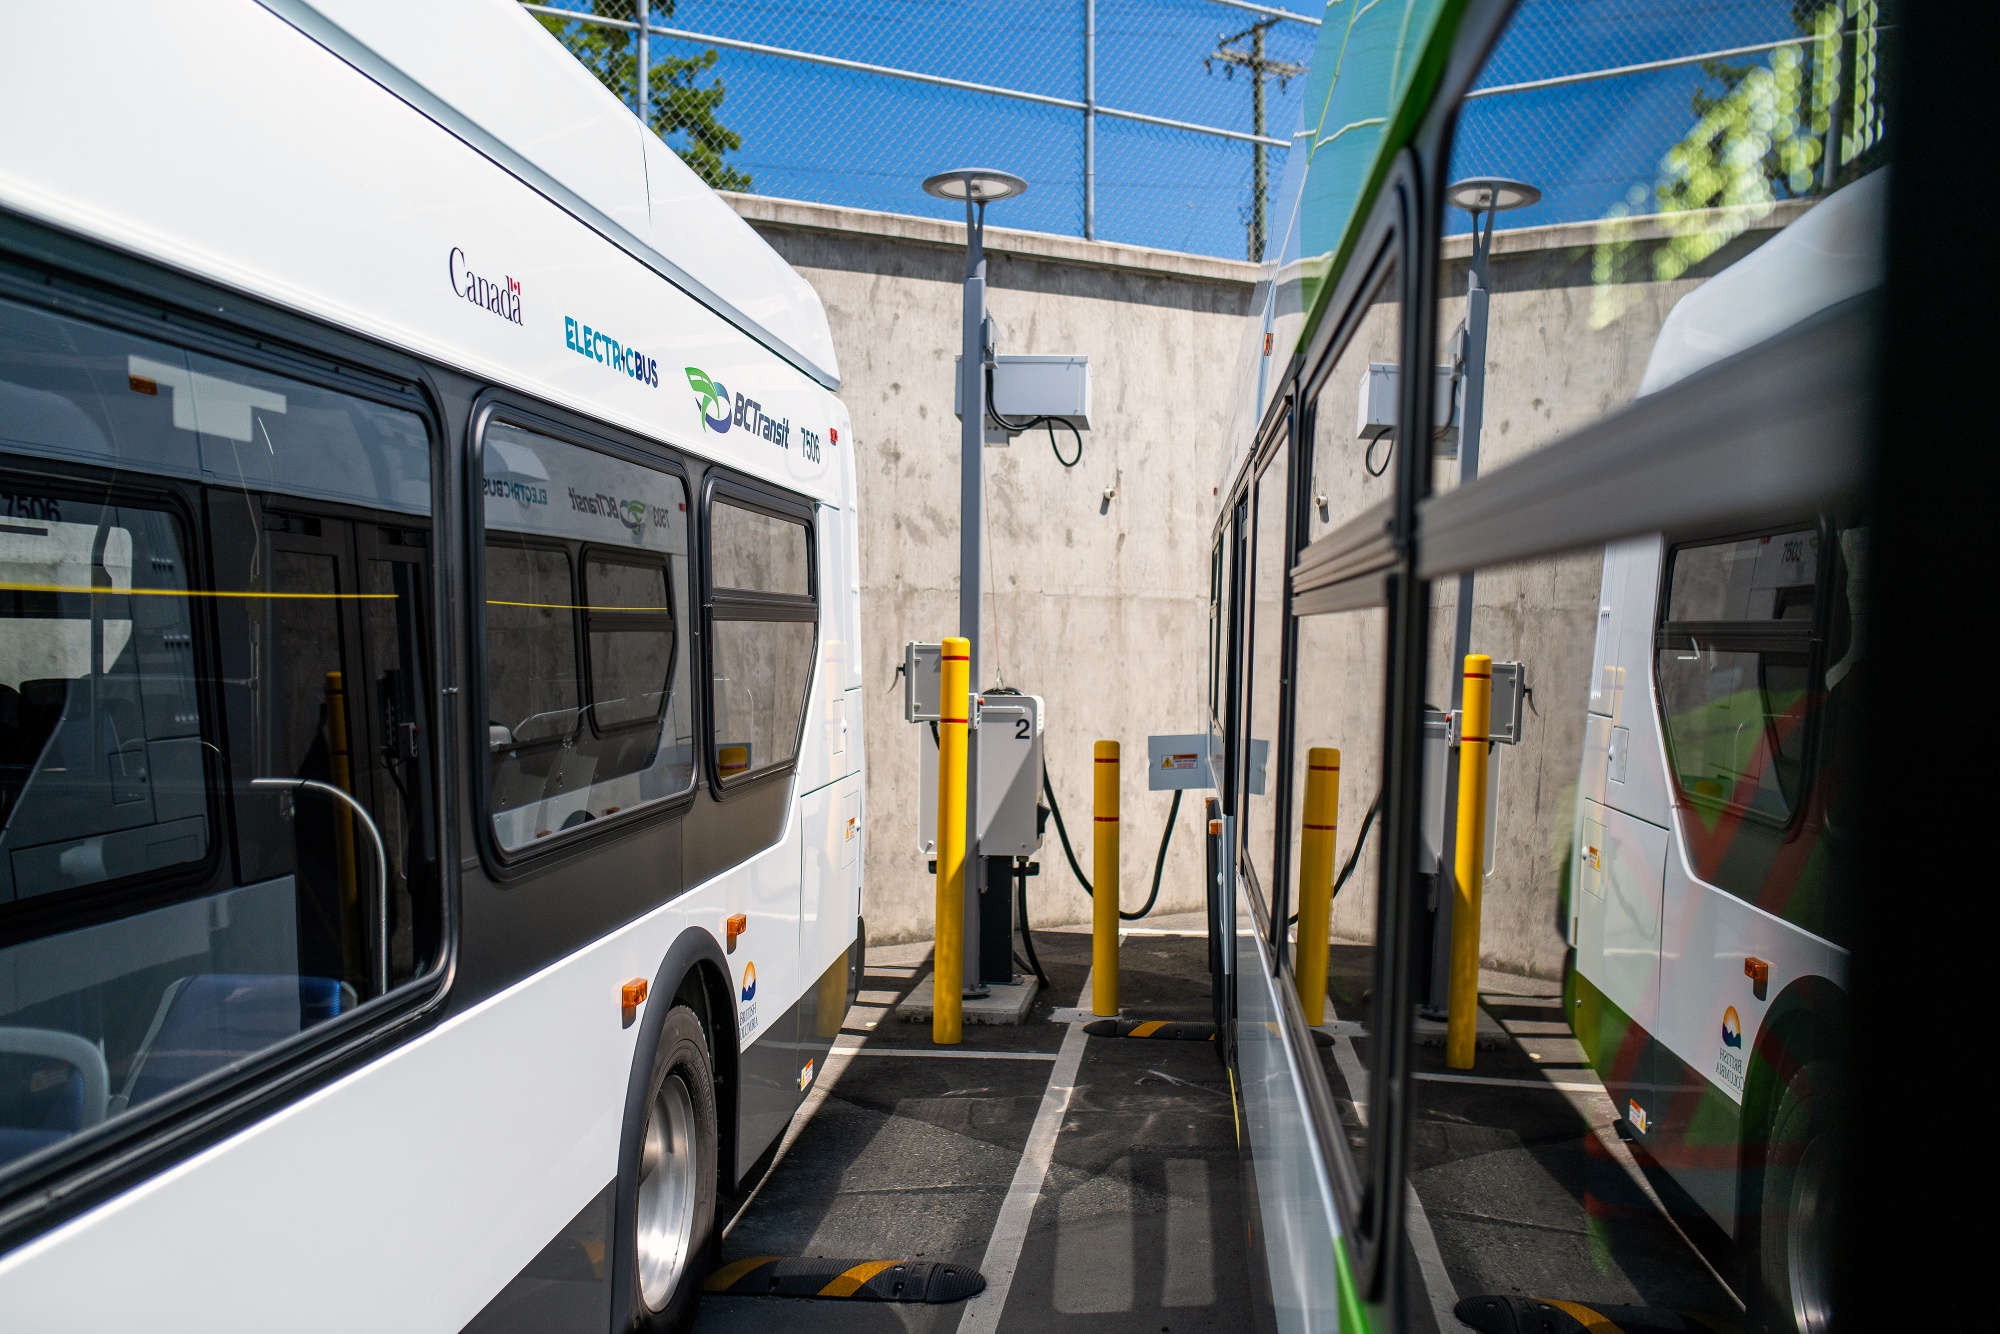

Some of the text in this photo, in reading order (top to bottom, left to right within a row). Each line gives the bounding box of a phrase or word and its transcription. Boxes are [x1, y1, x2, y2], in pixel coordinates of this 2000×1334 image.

[449, 247, 523, 326] Canada
[800, 426, 820, 464] 7506
[1015, 718, 1030, 740] 2
